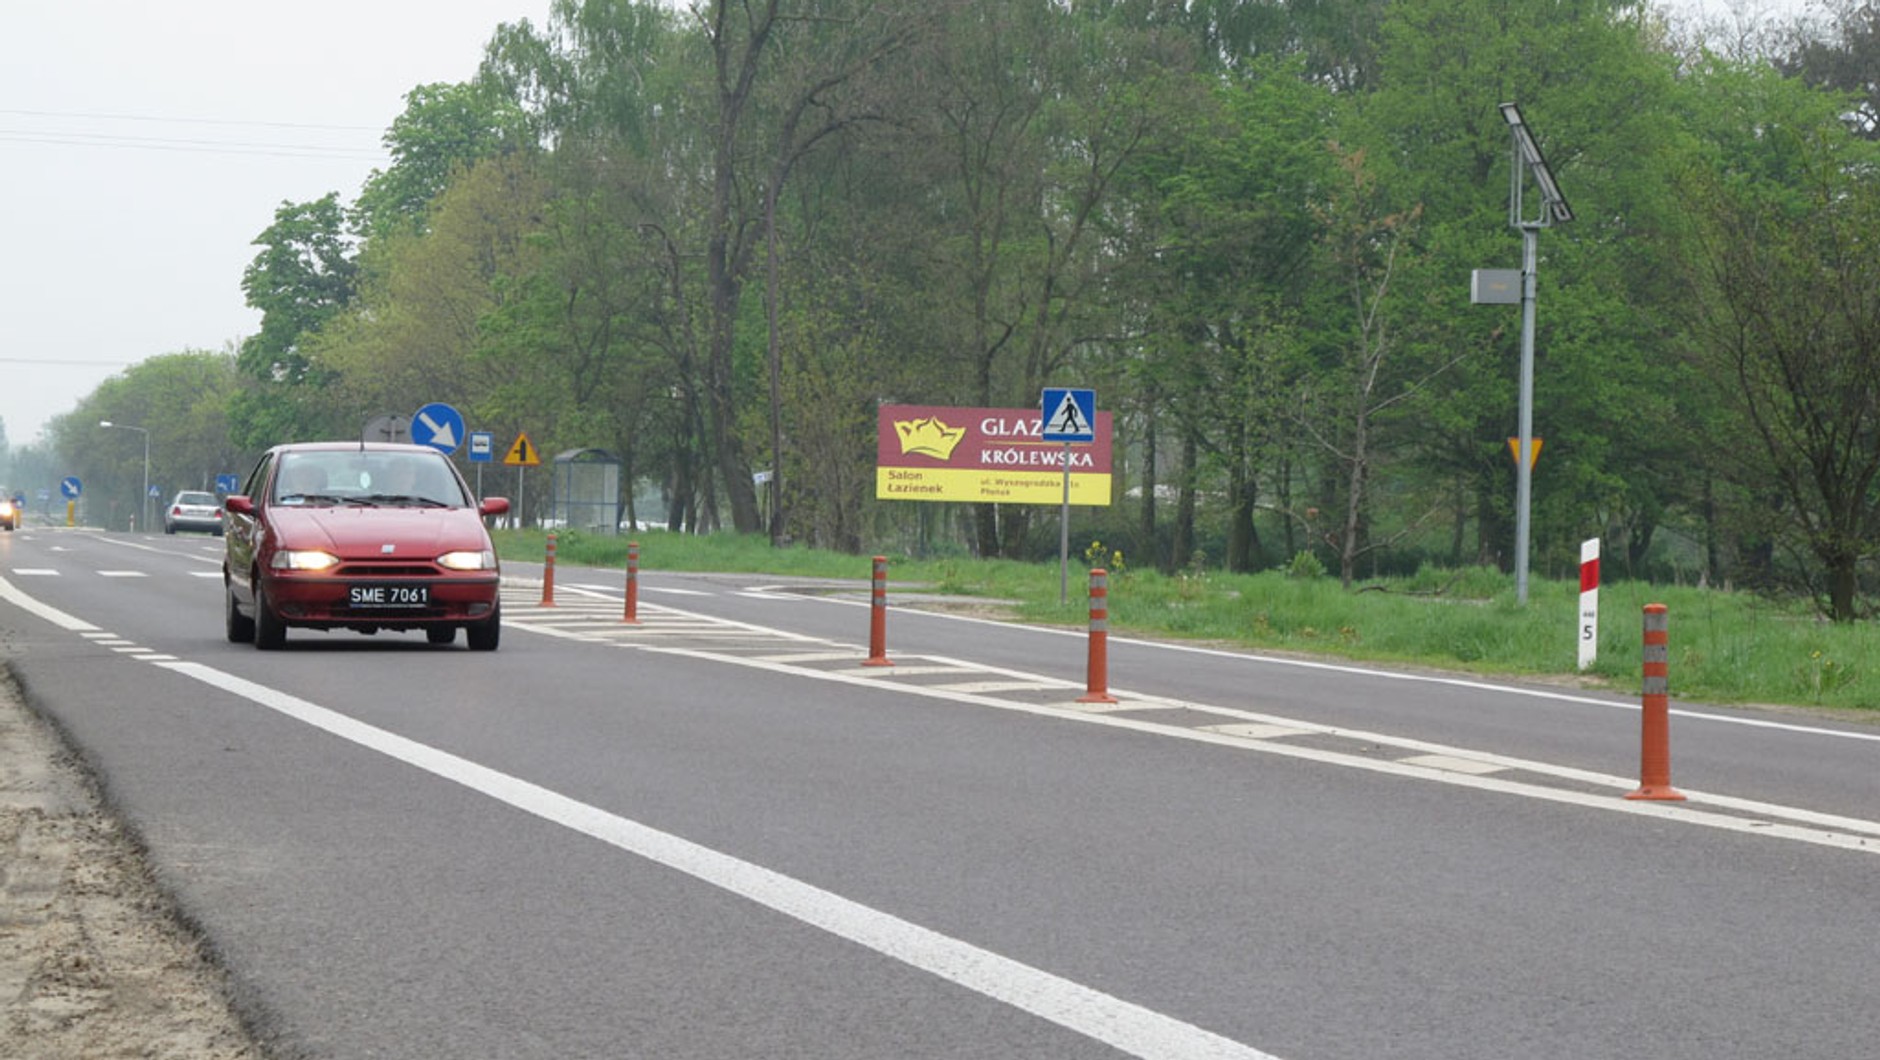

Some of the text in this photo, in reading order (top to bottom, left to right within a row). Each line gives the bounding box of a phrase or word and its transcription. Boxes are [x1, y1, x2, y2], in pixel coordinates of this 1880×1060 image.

[981, 418, 1043, 437] GLAZ
[981, 447, 1094, 467] KRÓLEWSKA
[888, 470, 923, 480] Salon
[351, 588, 427, 602] SME 7061
[1583, 625, 1593, 640] 5
